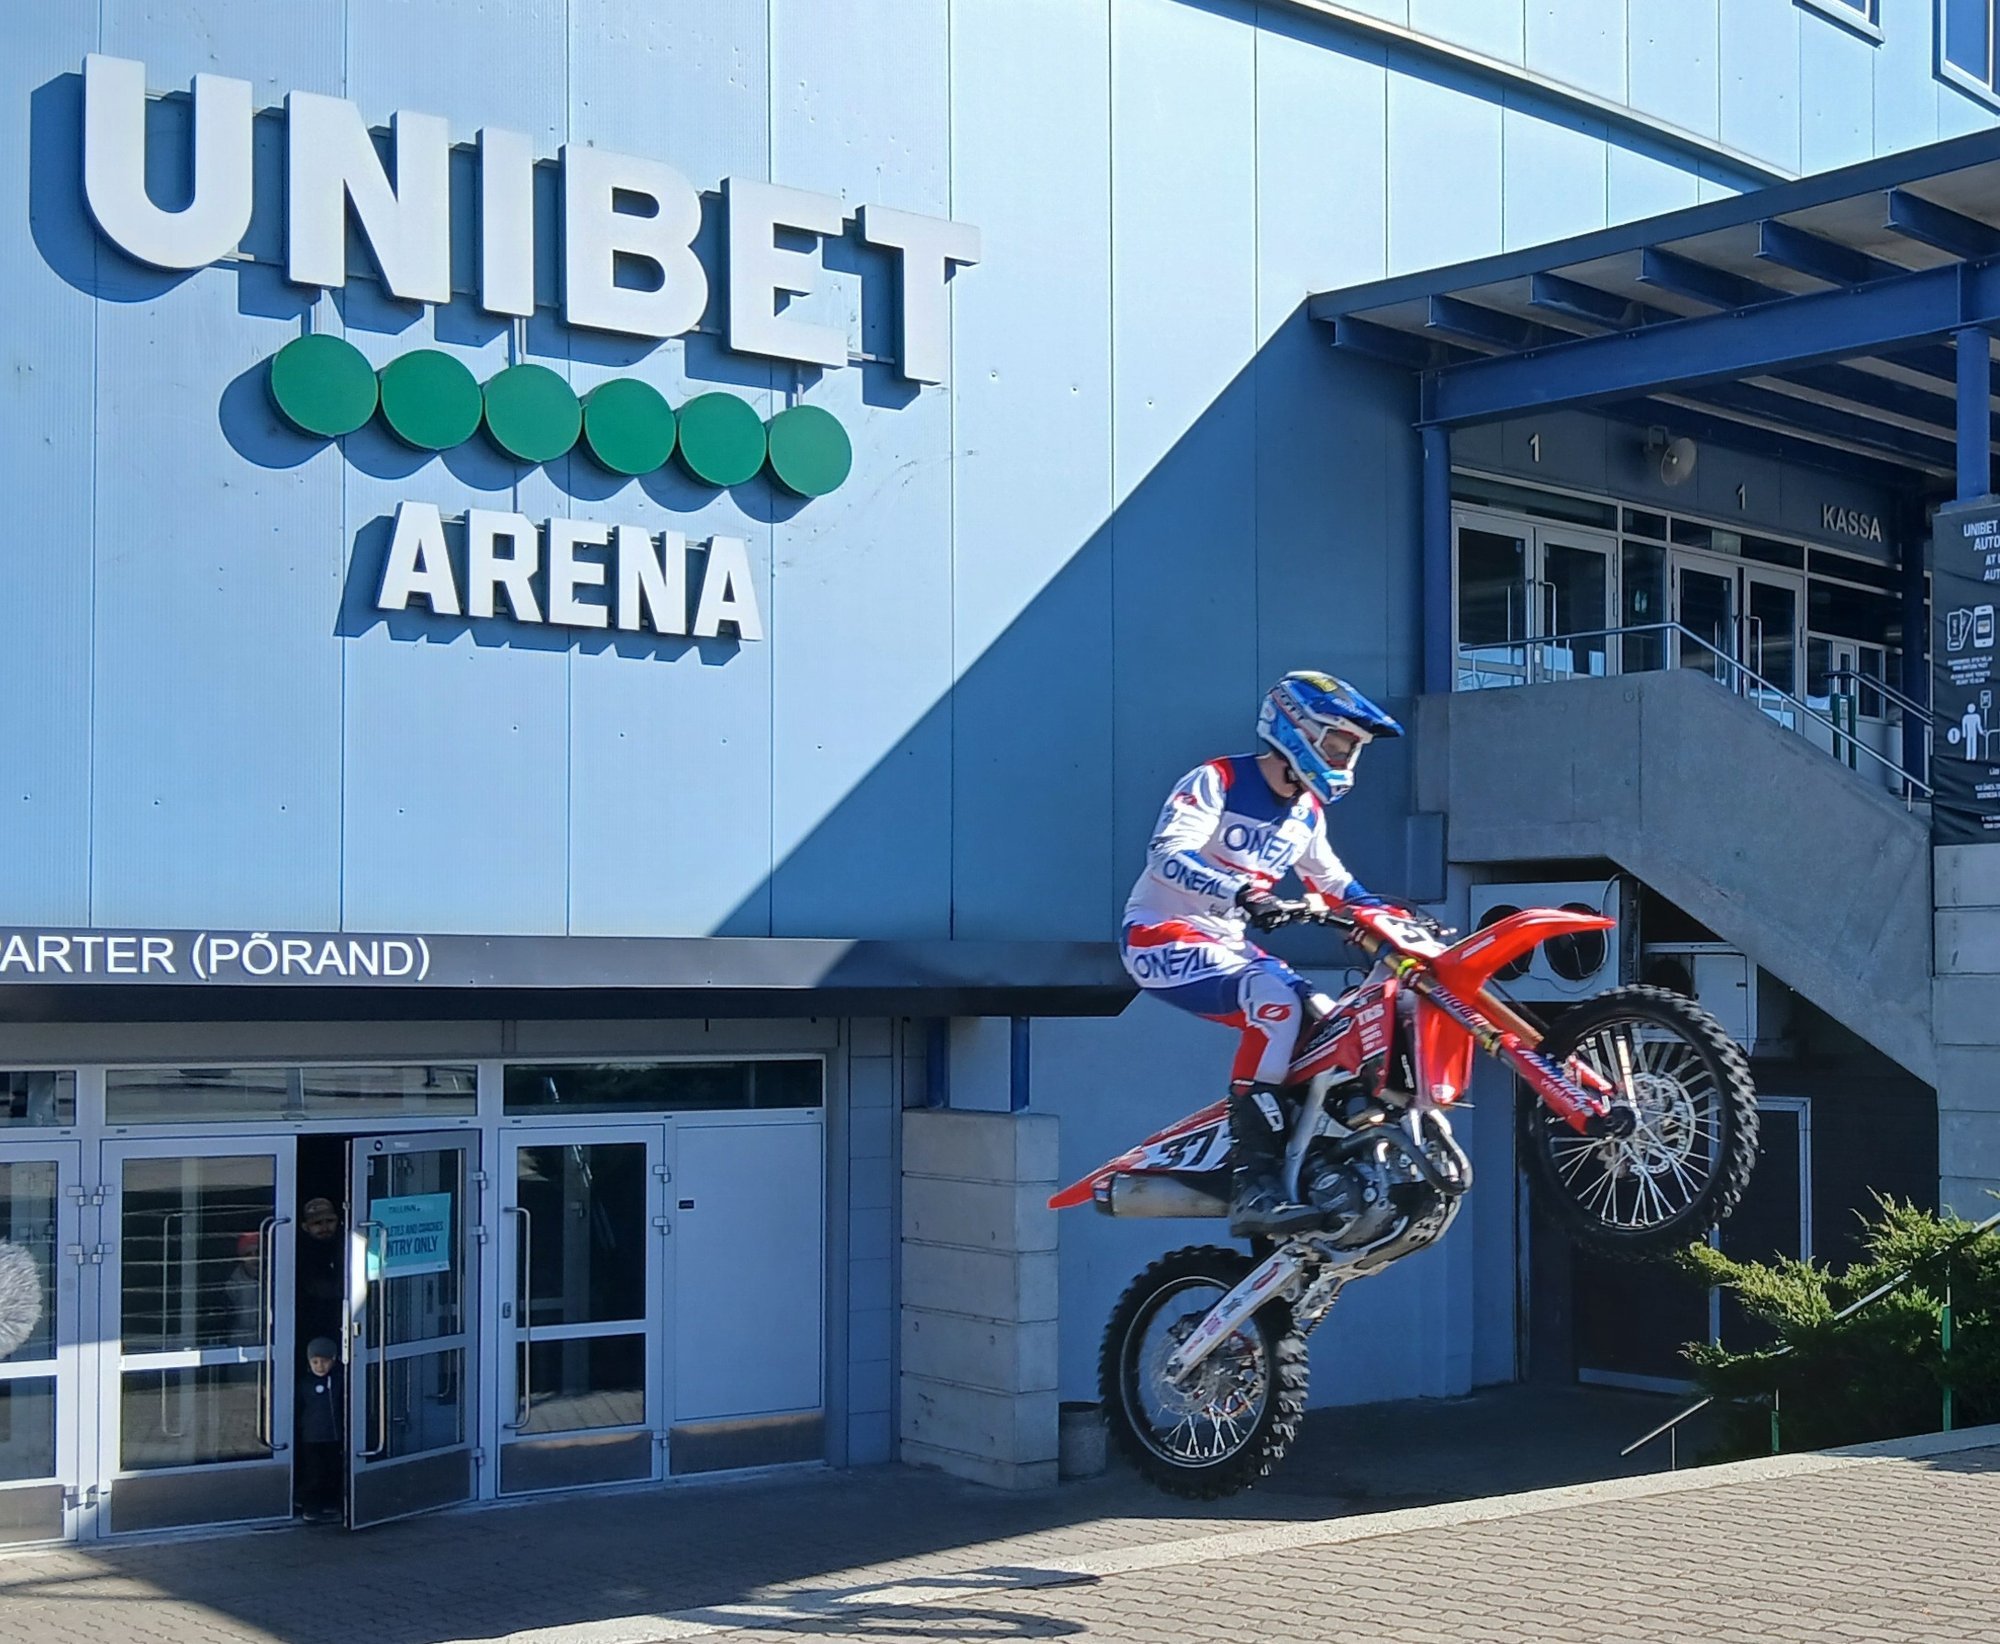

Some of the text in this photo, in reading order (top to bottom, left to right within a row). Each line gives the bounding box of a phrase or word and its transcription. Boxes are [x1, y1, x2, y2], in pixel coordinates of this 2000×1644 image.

[82, 53, 981, 386] UNIBET
[1529, 433, 1540, 462] 1
[1737, 484, 1746, 511] 1
[1822, 503, 1883, 543] KASSA
[1963, 520, 1998, 537] UNIBET
[376, 501, 764, 642] ARENA
[1985, 554, 1996, 566] AT
[0, 933, 431, 981] ARTER (PÕRAND)
[386, 1235, 439, 1257] NTRY ONLY
